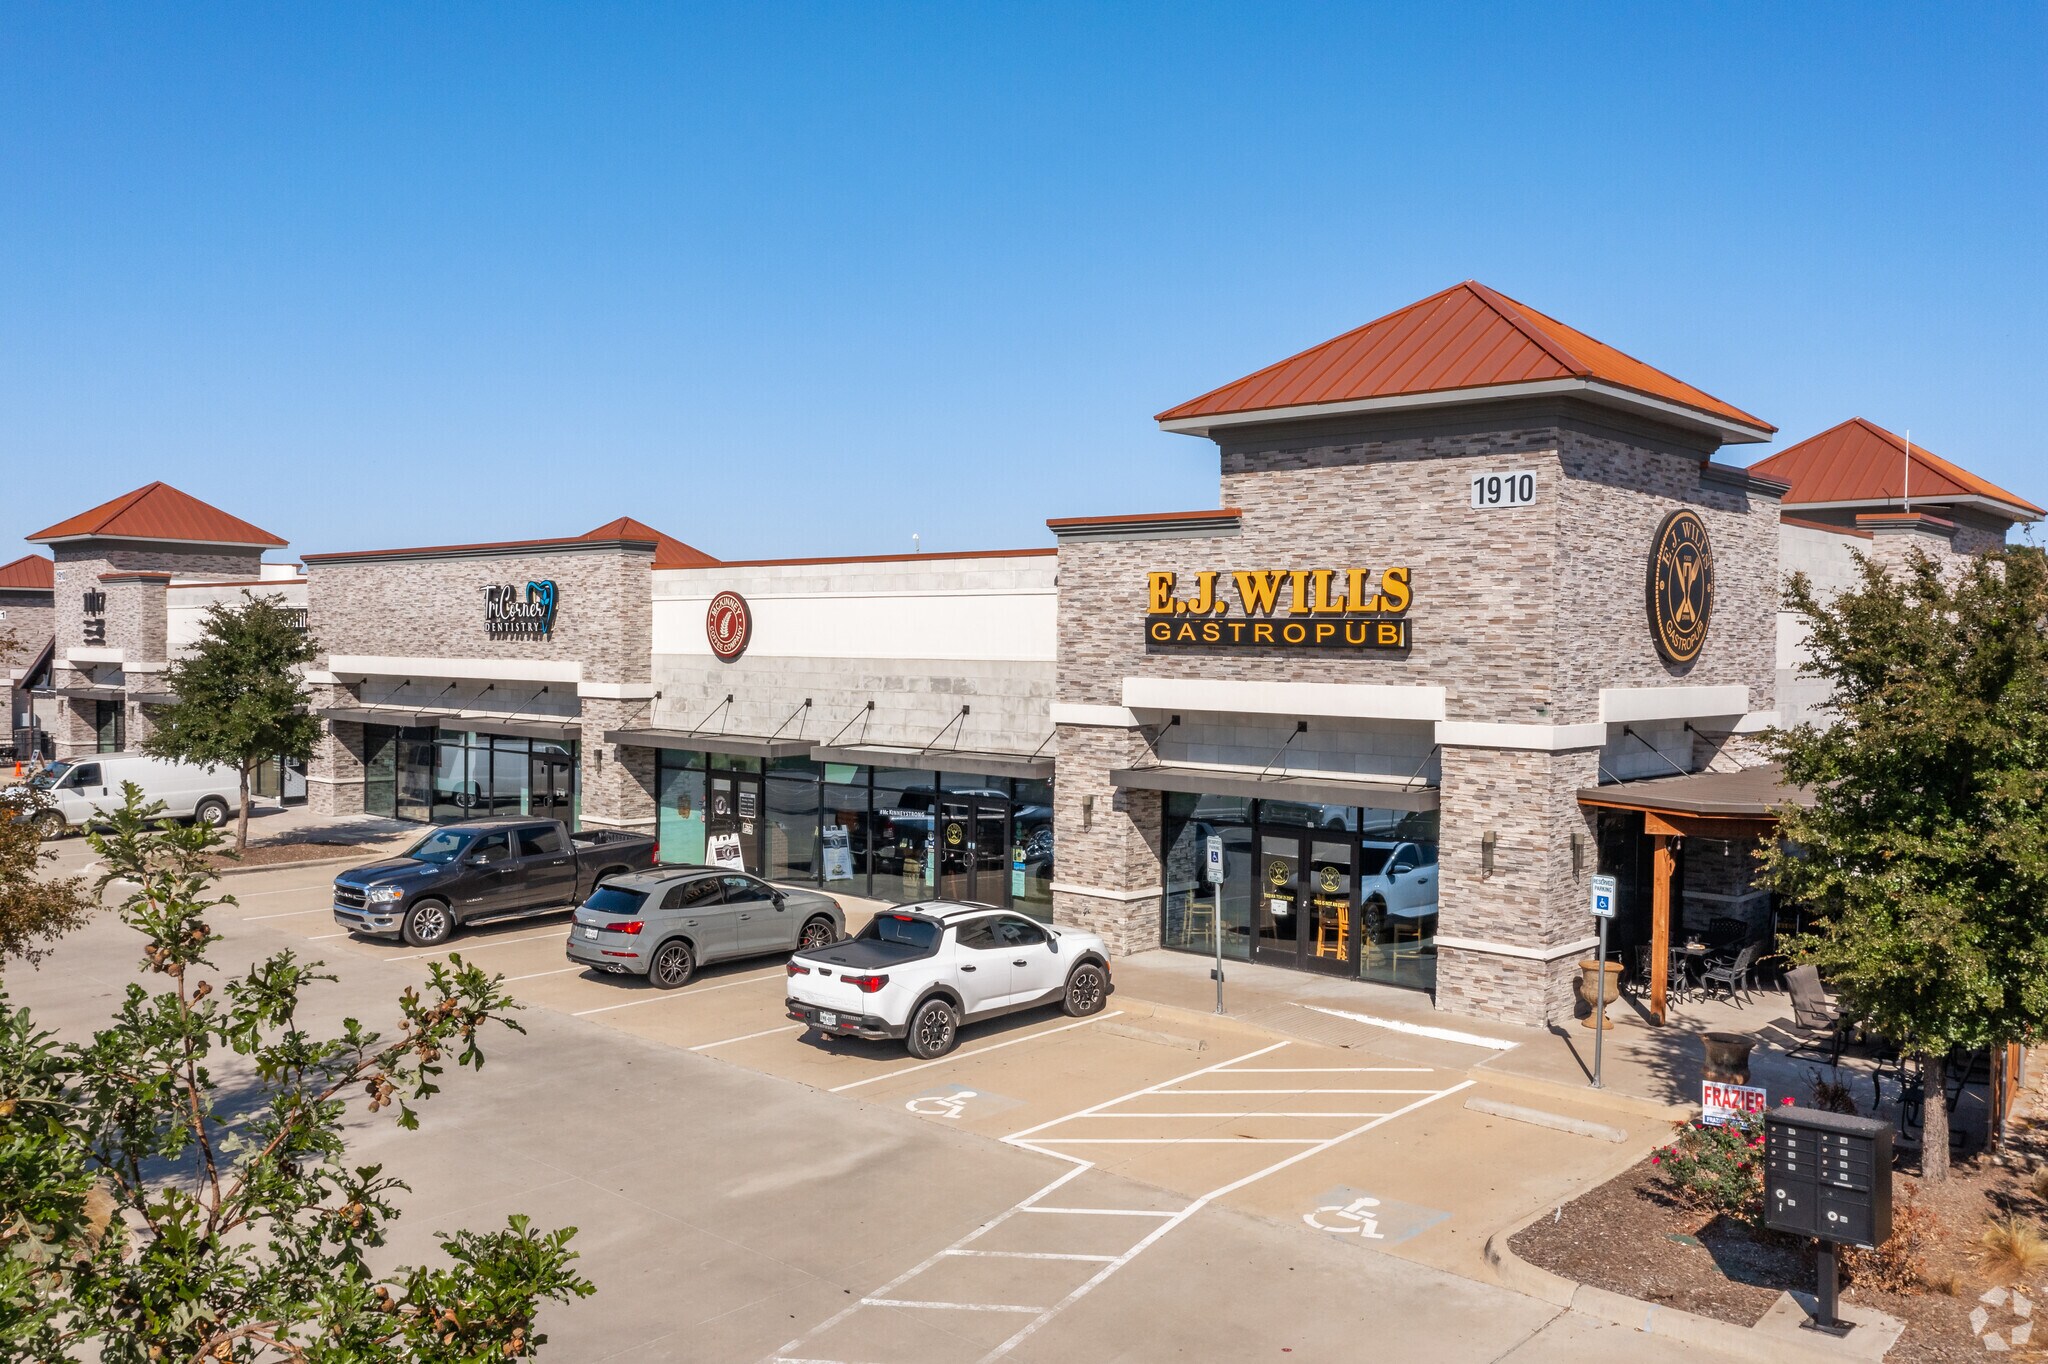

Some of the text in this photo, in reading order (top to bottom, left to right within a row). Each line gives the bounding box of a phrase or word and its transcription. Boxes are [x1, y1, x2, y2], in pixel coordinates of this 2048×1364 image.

[1473, 474, 1534, 505] 1910
[1682, 521, 1711, 570] WILLS
[480, 584, 545, 621] TriCorner
[1146, 566, 1411, 615] E.J. WILLS
[484, 622, 539, 632] DENTISTRY
[710, 625, 743, 652] COFFEE COMPANY
[1151, 621, 1399, 645] GASTROPUB
[1665, 619, 1704, 651] GASTROPUB
[1593, 878, 1614, 887] RESERVED
[1594, 885, 1612, 893] PARKING
[1704, 1086, 1765, 1112] FRAZIER
